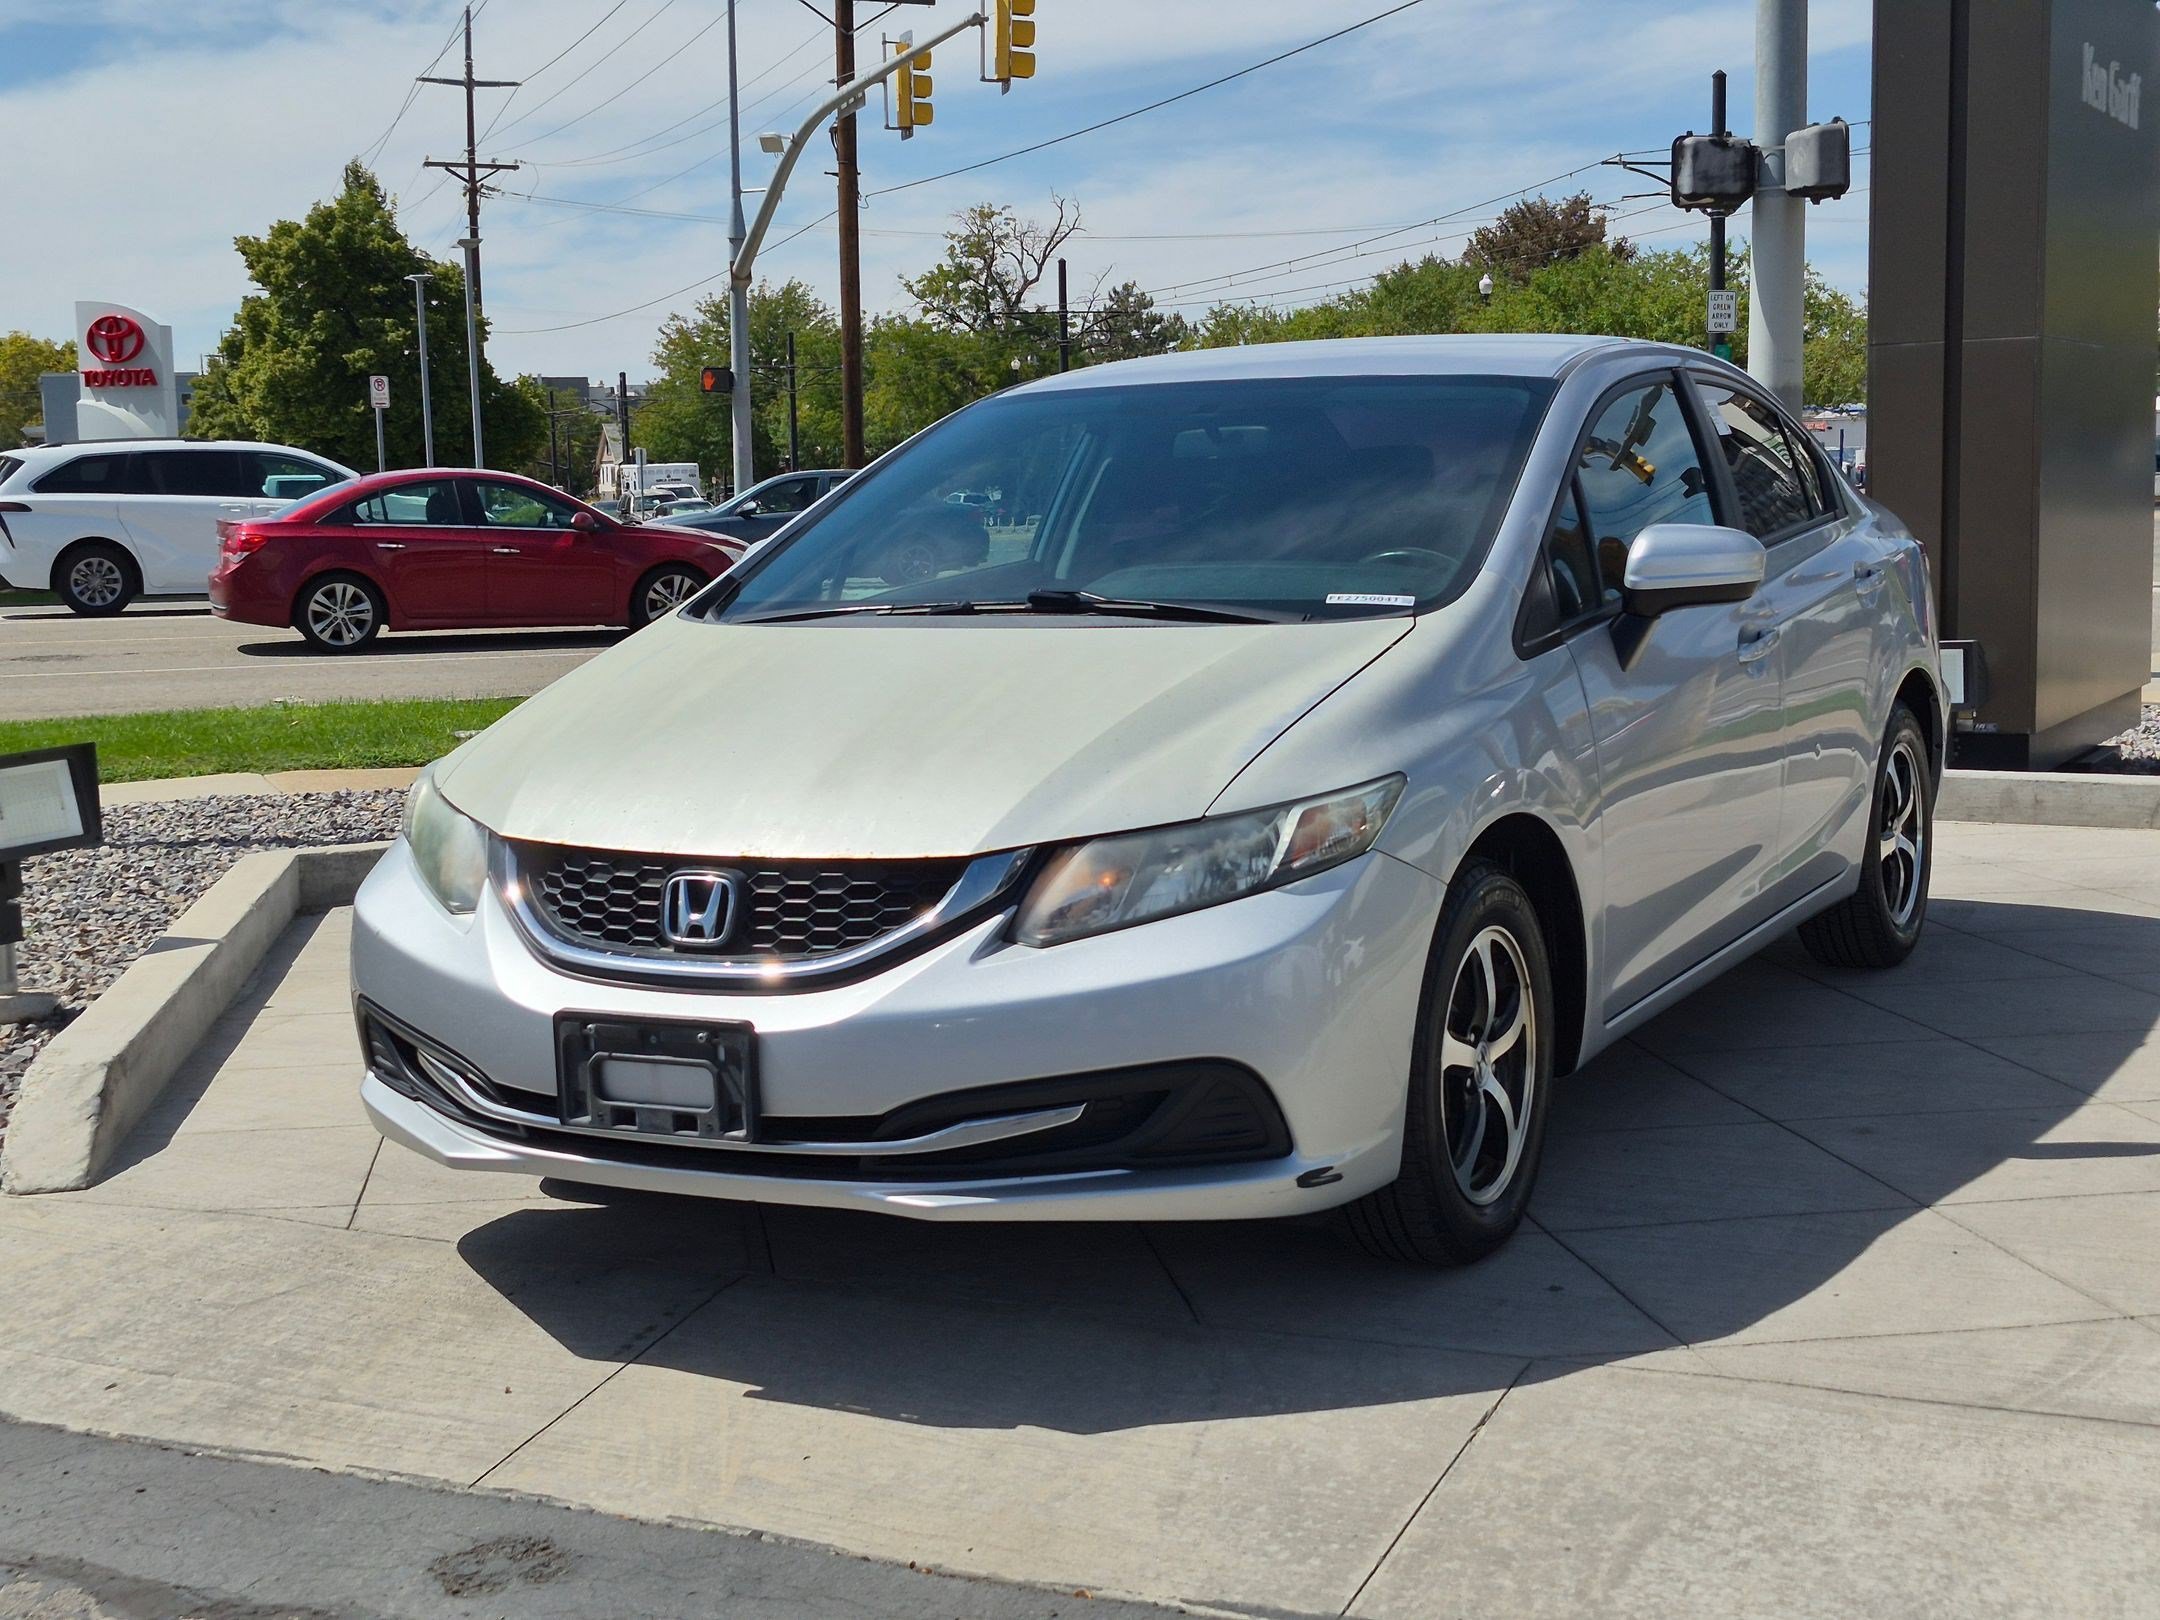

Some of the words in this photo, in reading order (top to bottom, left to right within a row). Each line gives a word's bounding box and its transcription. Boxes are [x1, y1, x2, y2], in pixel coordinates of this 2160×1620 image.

[1712, 303, 1731, 311] GREEN
[1712, 312, 1731, 320] ARROW
[1713, 321, 1729, 329] ONLY
[81, 368, 158, 387] TOYOTA
